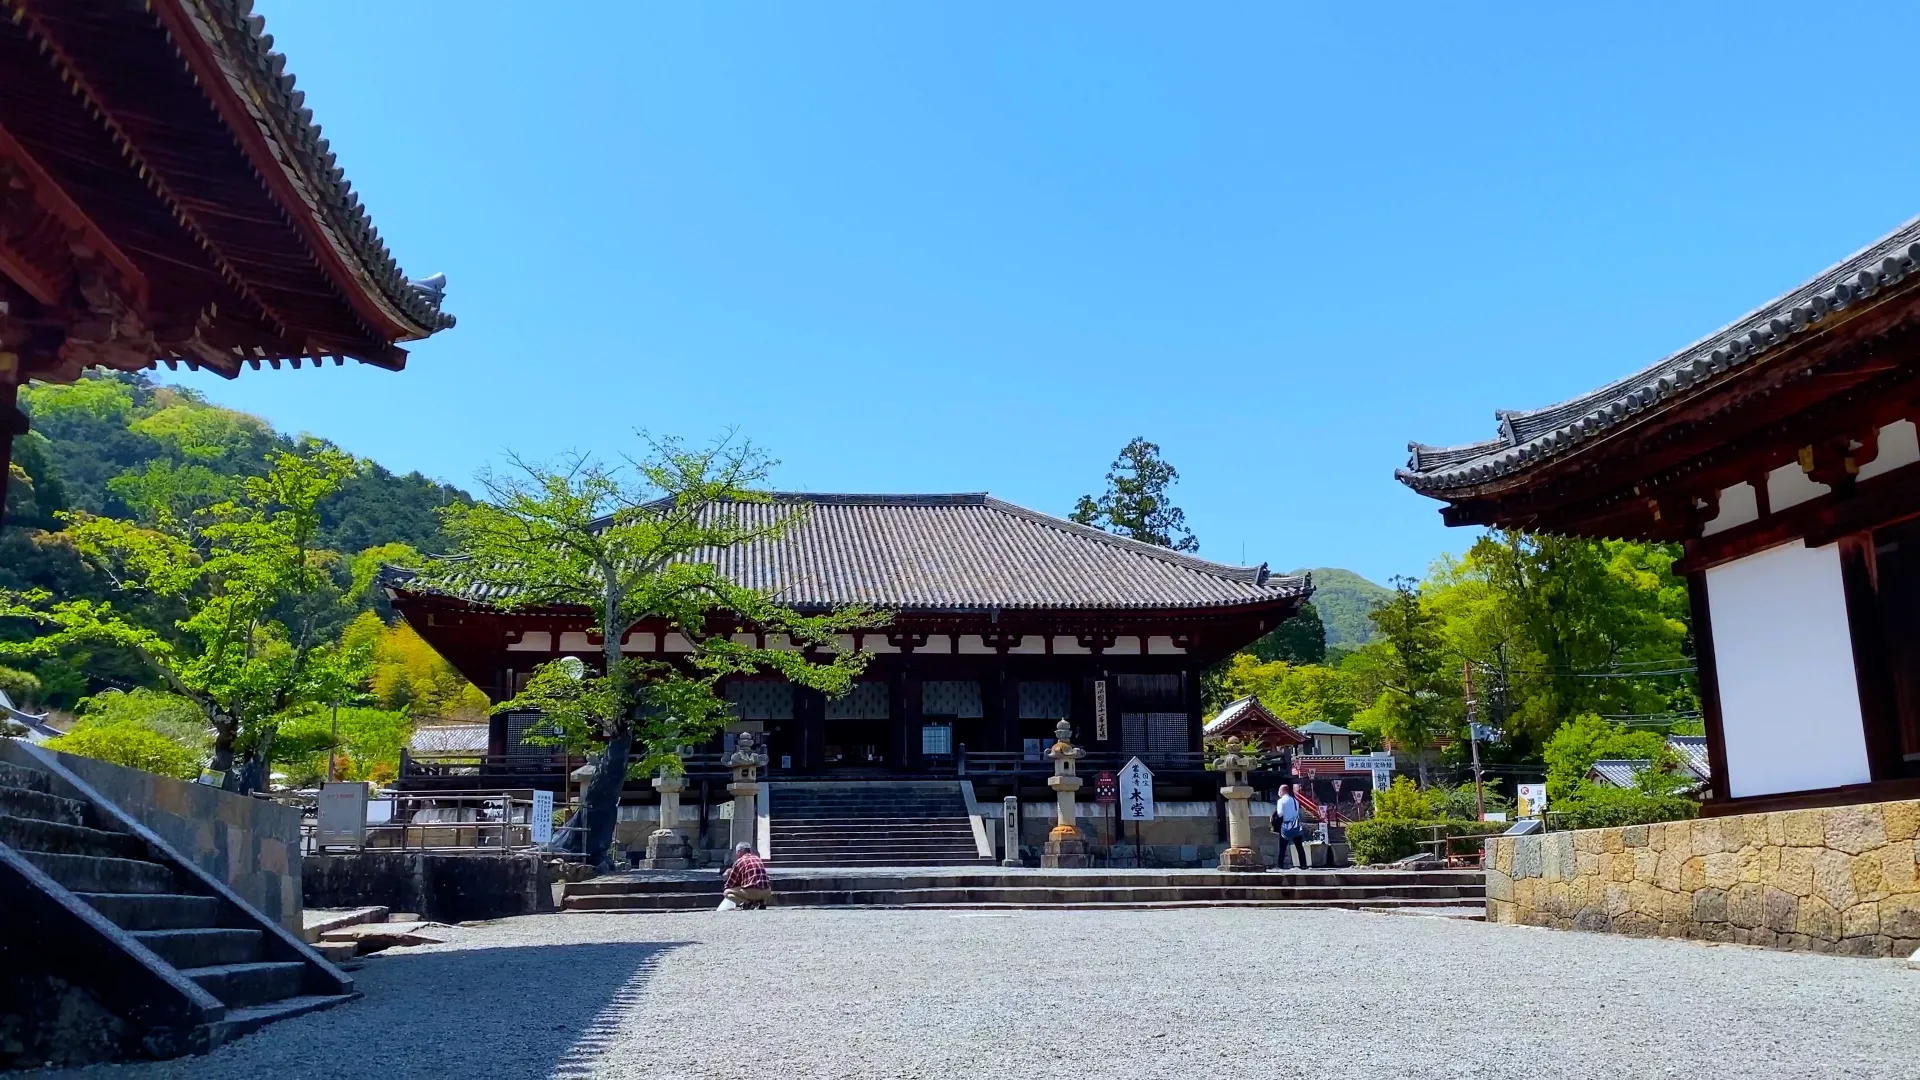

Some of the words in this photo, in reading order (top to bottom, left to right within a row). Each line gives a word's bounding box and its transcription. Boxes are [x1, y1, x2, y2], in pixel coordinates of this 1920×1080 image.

[1374, 761, 1392, 769] 宝物館
[1129, 788, 1145, 817] 本堂
